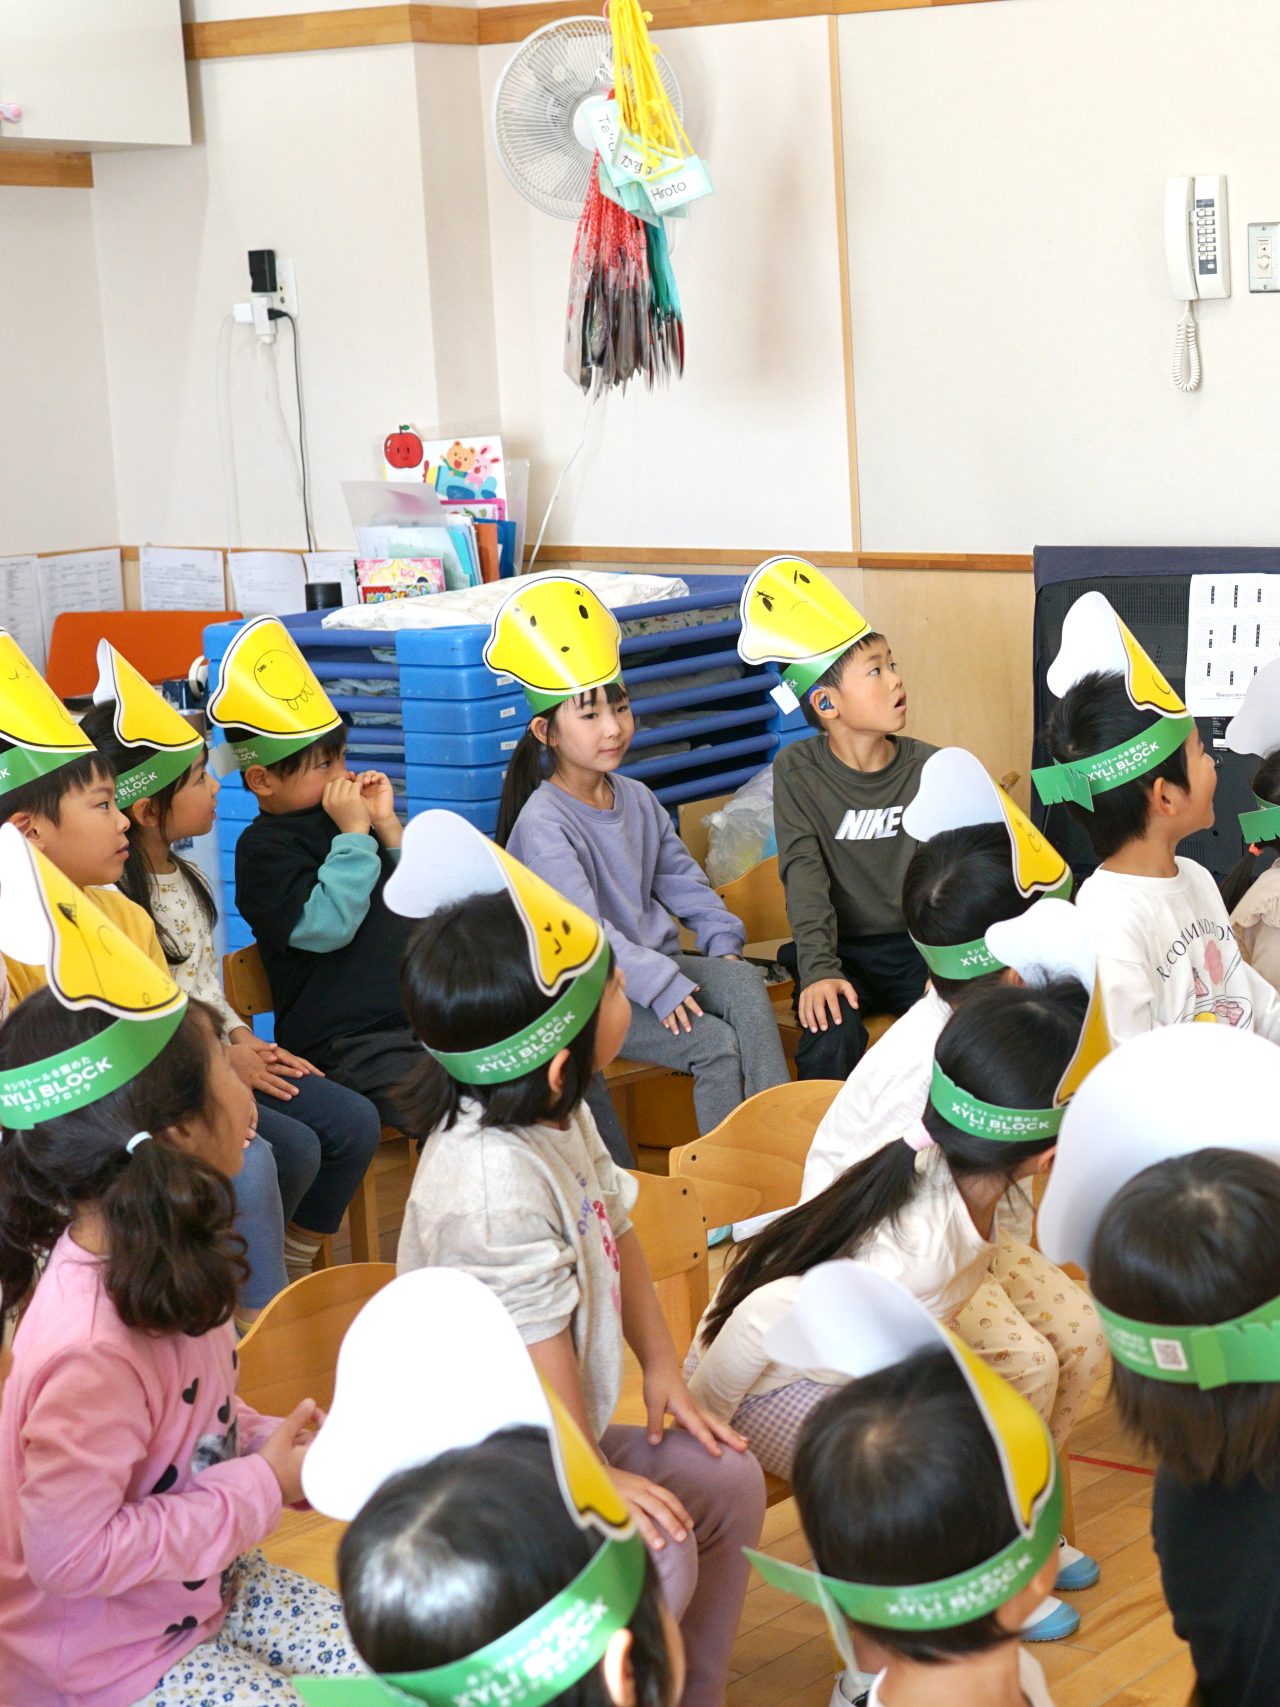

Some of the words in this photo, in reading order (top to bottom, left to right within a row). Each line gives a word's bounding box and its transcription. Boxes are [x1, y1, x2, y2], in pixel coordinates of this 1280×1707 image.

[650, 181, 687, 201] Hiroto
[1087, 765, 1115, 782] XYLI
[1116, 741, 1160, 771] BLOCK
[118, 771, 158, 796] BLOCK
[834, 805, 904, 840] NIKE
[475, 1055, 518, 1074] XYLI
[519, 1010, 576, 1059] BLOCK
[0, 1089, 38, 1108] XYLI
[38, 1056, 113, 1100] BLOCK
[951, 1102, 985, 1126] XYLI
[988, 1119, 1051, 1132] BLOCK
